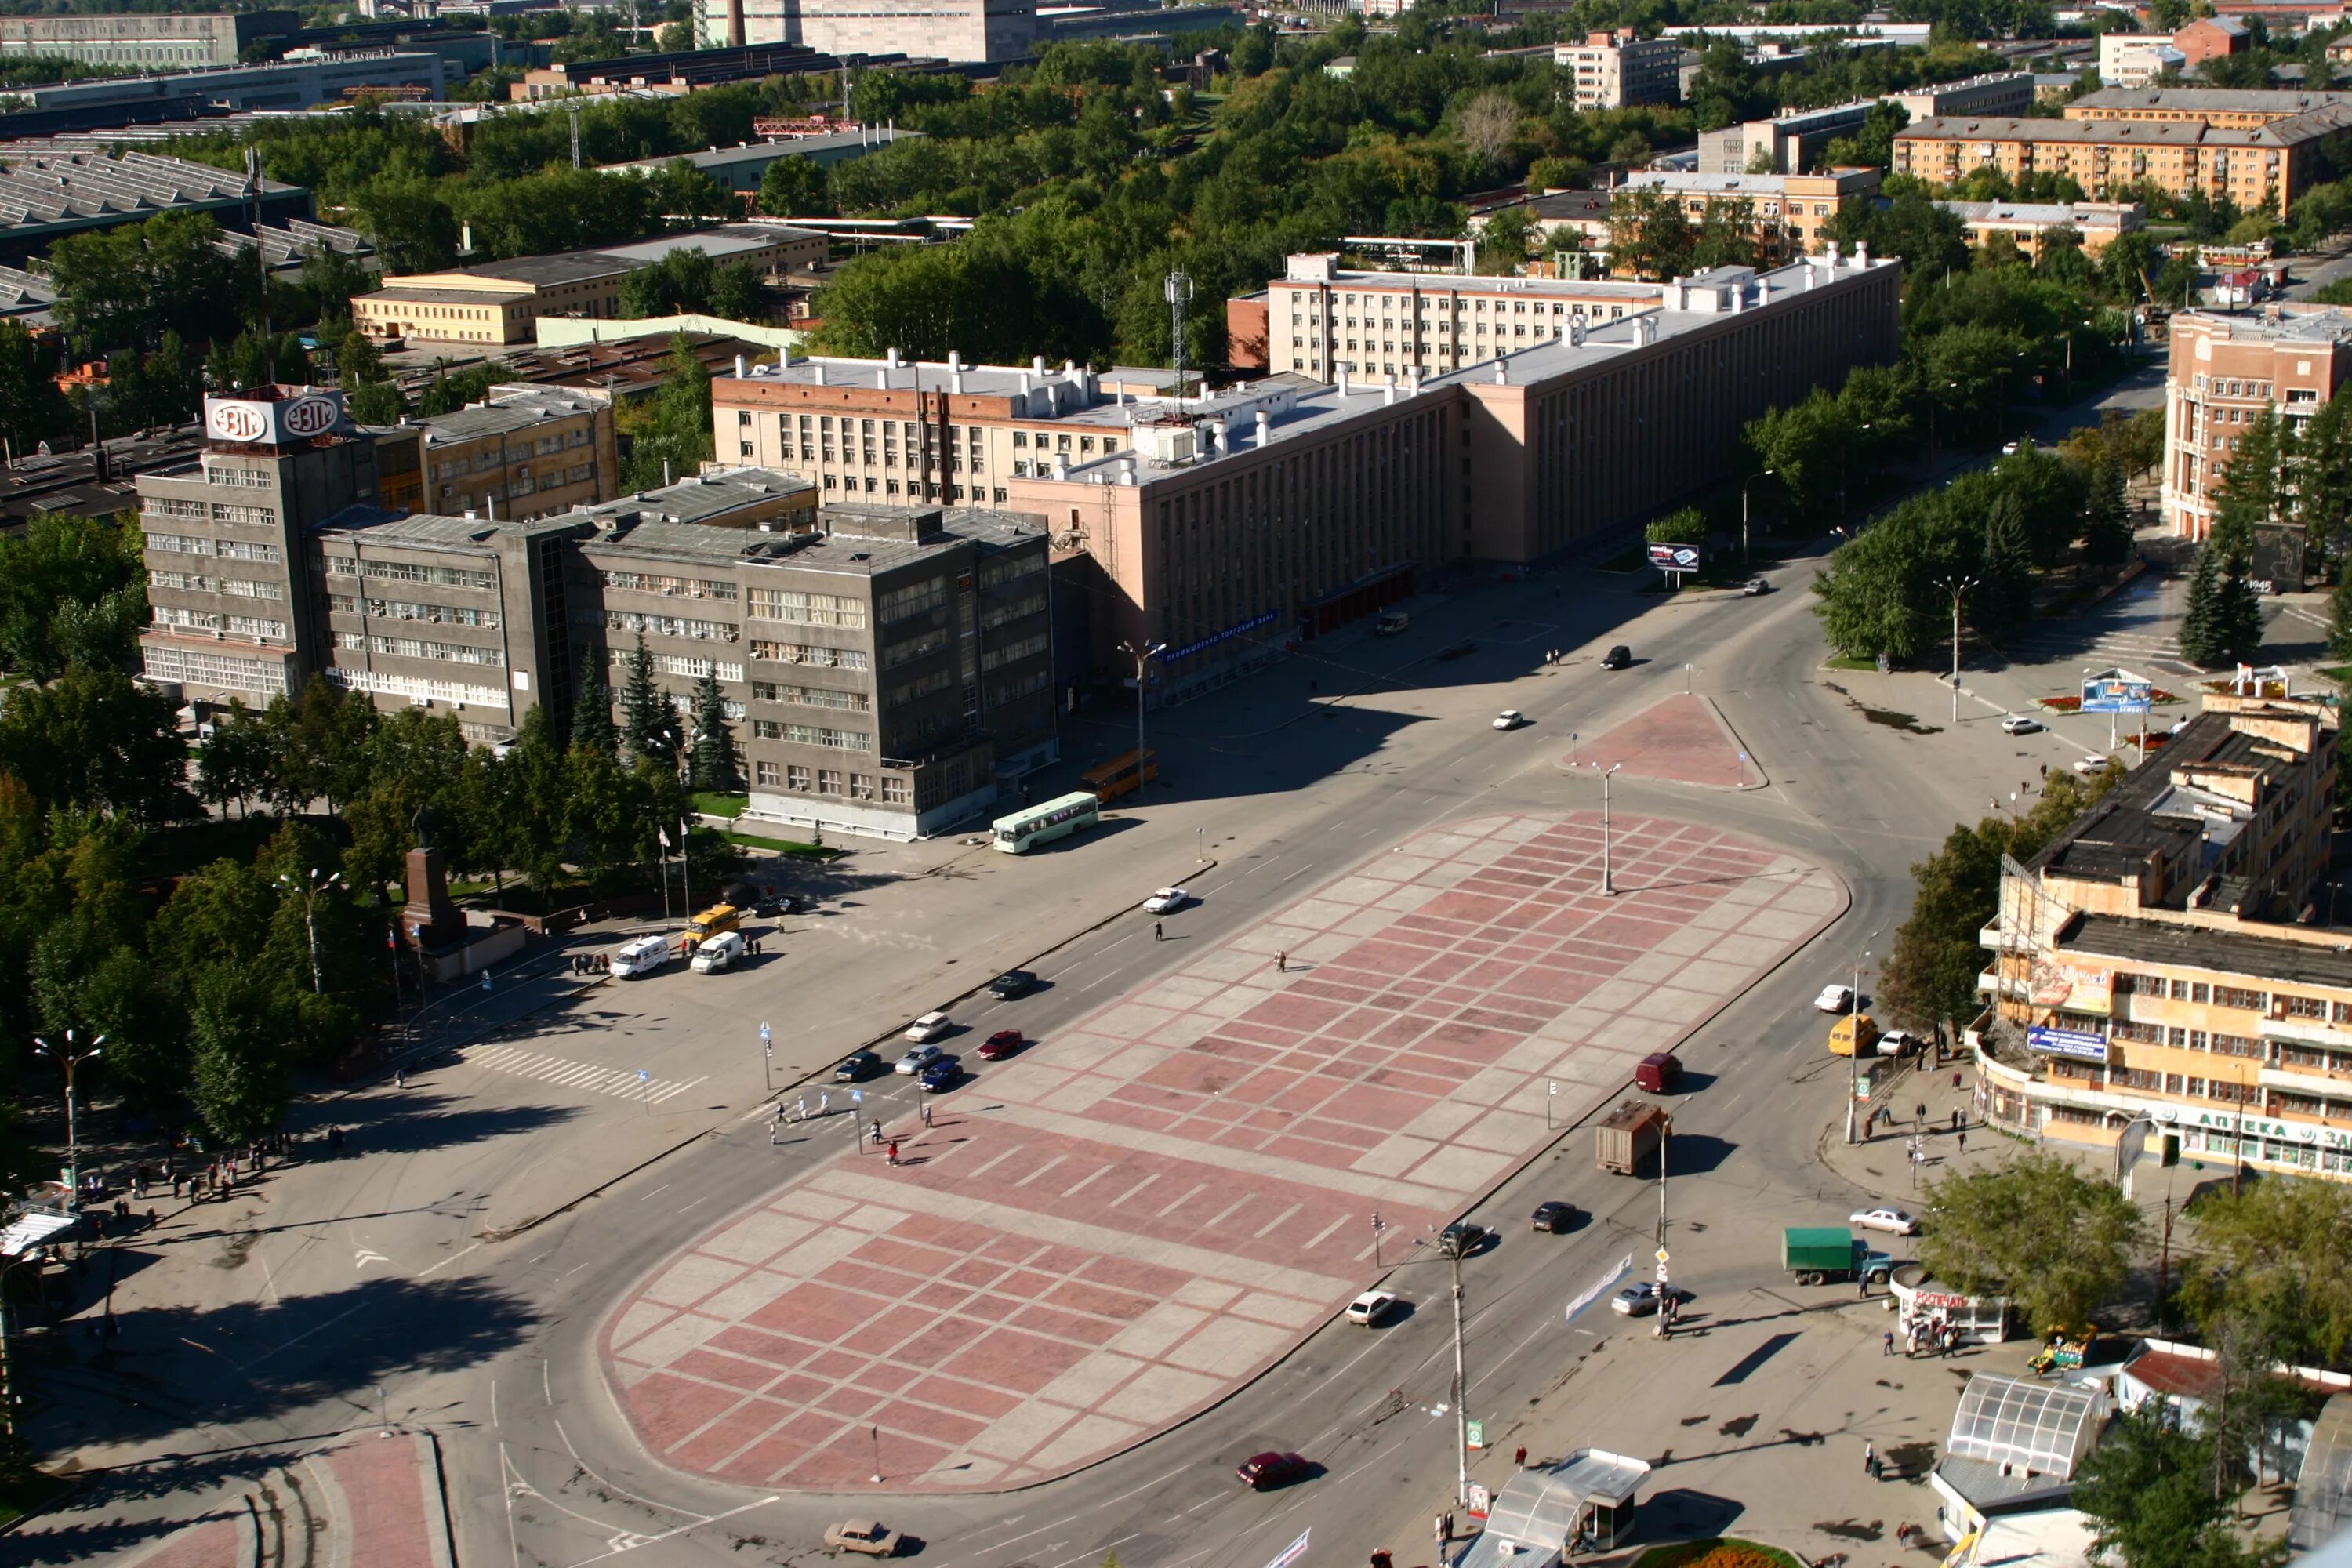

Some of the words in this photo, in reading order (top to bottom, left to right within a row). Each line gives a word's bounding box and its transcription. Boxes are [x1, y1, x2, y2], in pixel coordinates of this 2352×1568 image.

[217, 407, 260, 436] УЗТМ
[290, 401, 333, 431] УЗТМ
[2249, 579, 2272, 592] 1945
